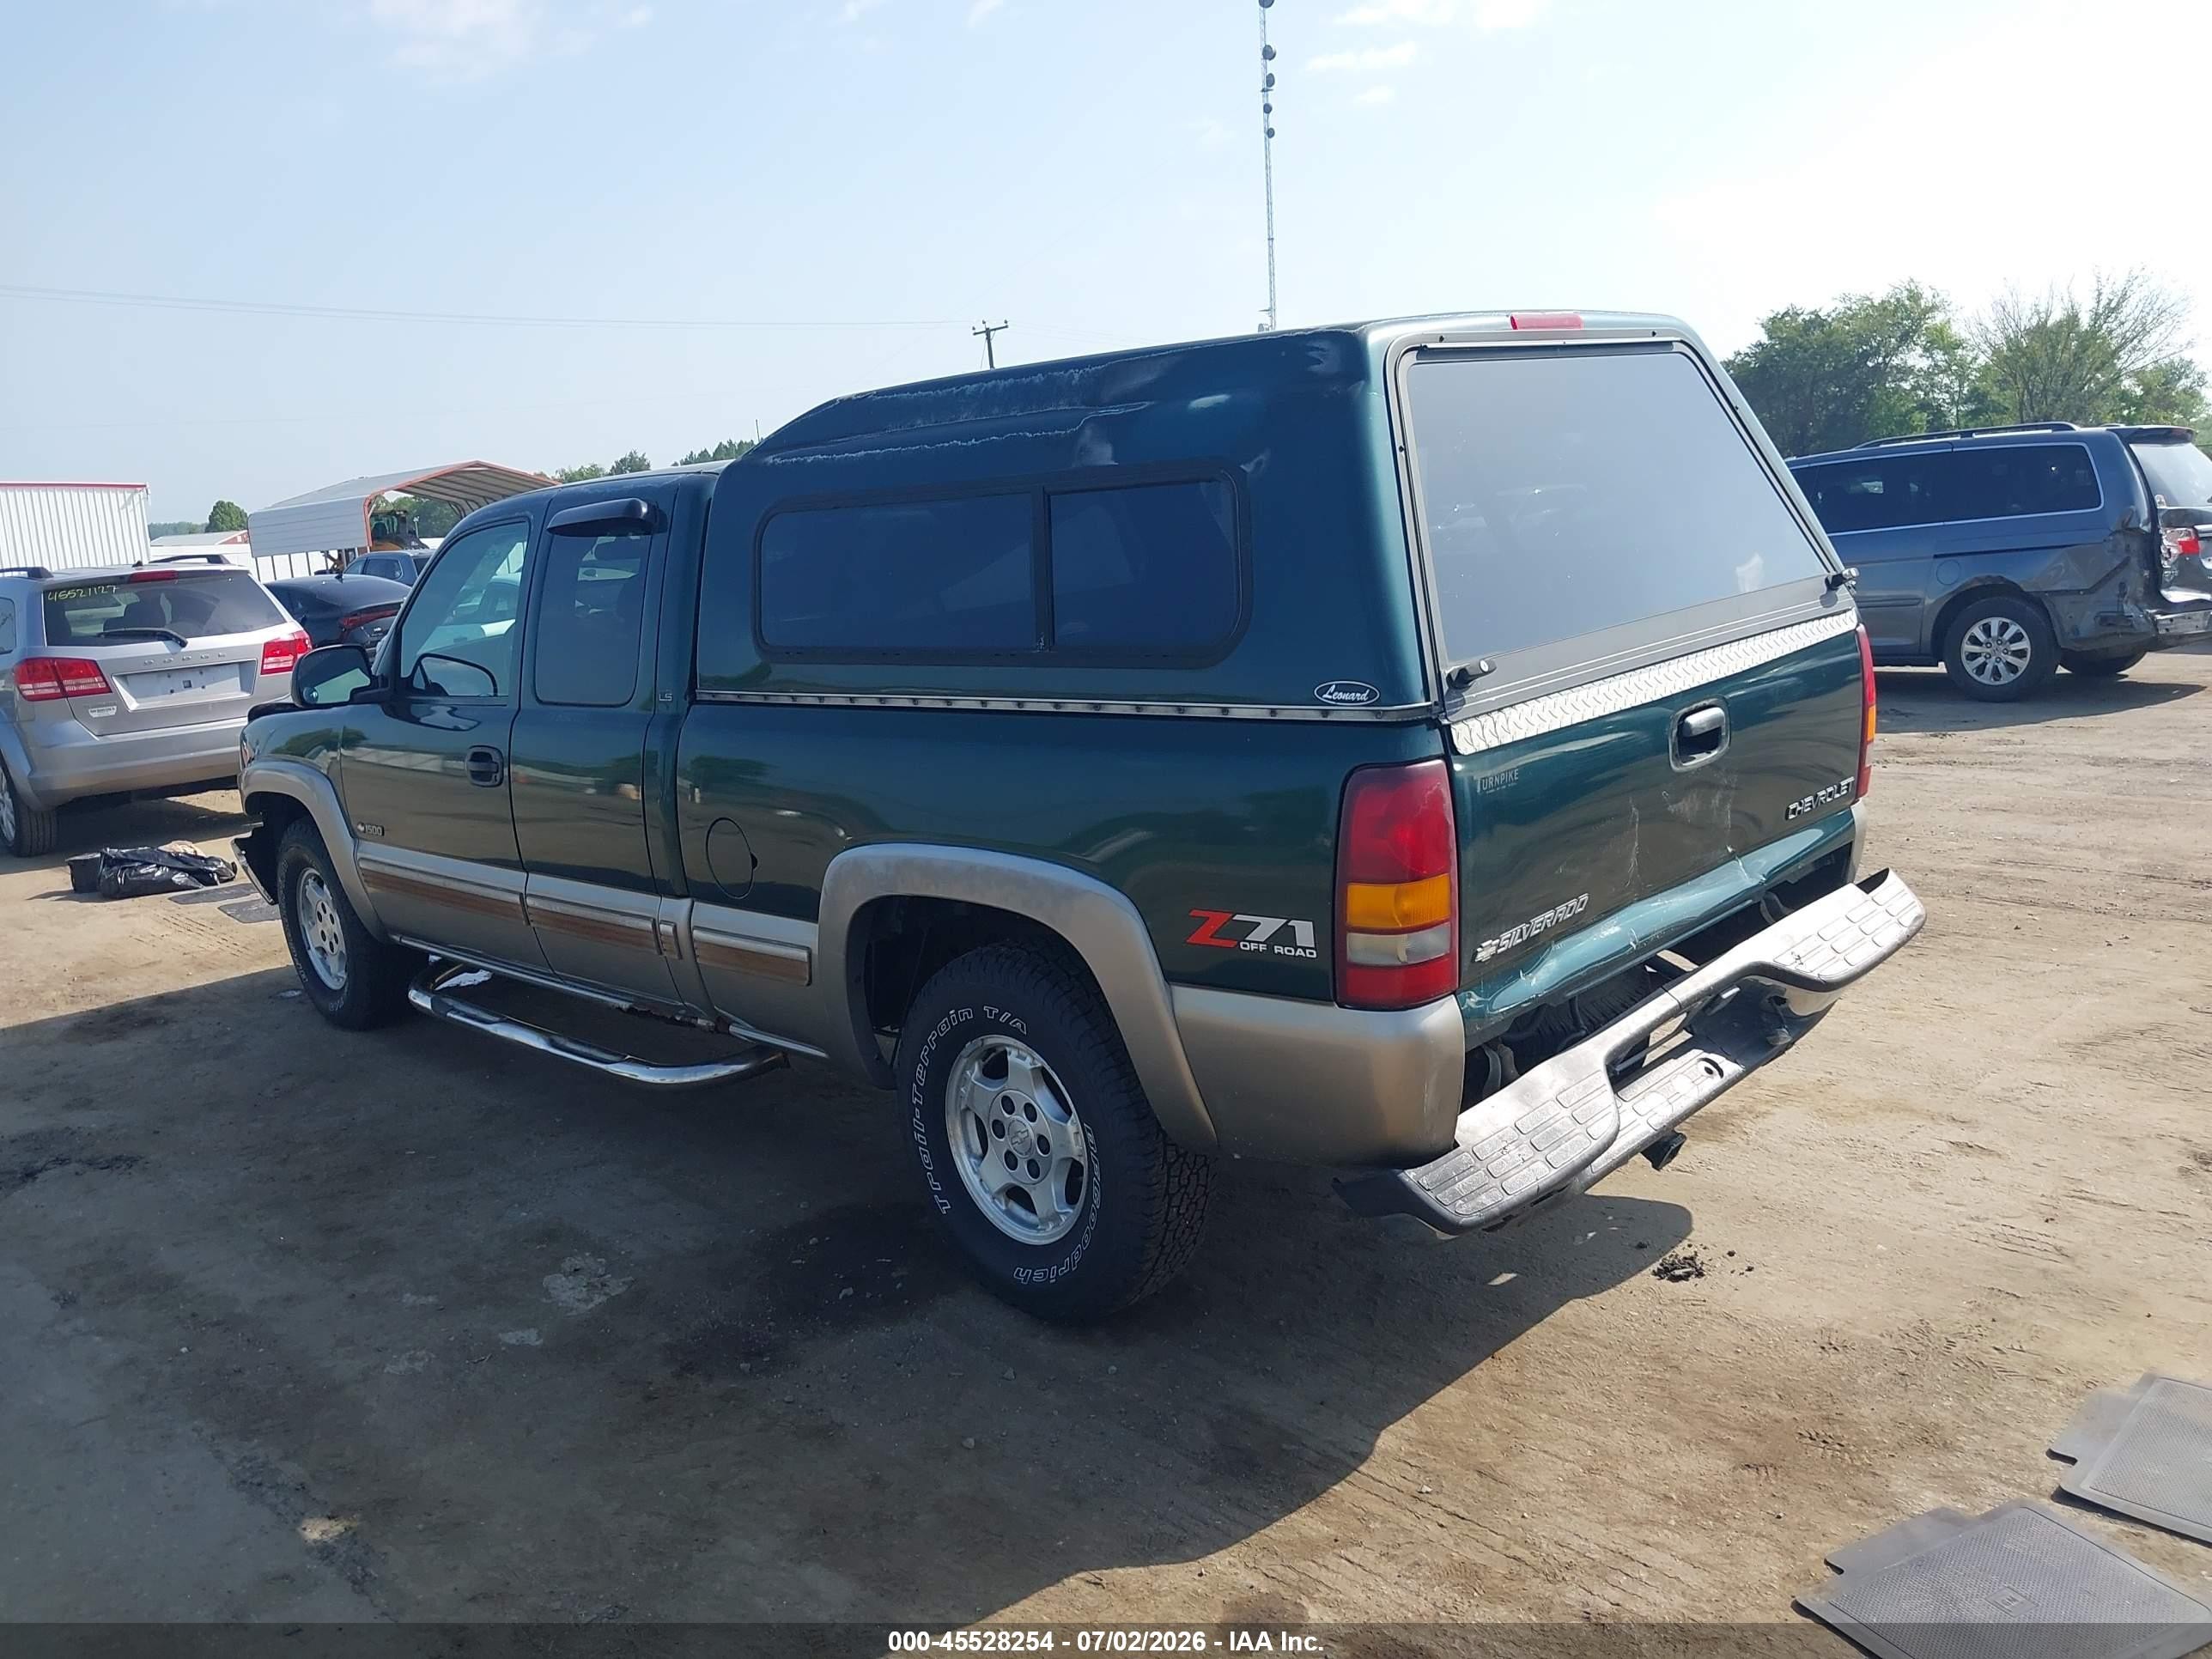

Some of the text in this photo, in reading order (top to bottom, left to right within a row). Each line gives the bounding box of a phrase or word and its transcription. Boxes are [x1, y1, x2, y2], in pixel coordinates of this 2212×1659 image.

[659, 693, 672, 702] LS
[1322, 684, 1370, 701] Leonard
[1474, 769, 1519, 793] TURNPIKE
[1787, 776, 1855, 820] CHEVROLET
[365, 823, 383, 836] 1500
[1186, 908, 1316, 948] Z71
[1496, 893, 1590, 954] SILVERADO
[1239, 941, 1317, 958] OFF ROAD
[912, 1005, 1029, 1214] Trail-Terrain T/A
